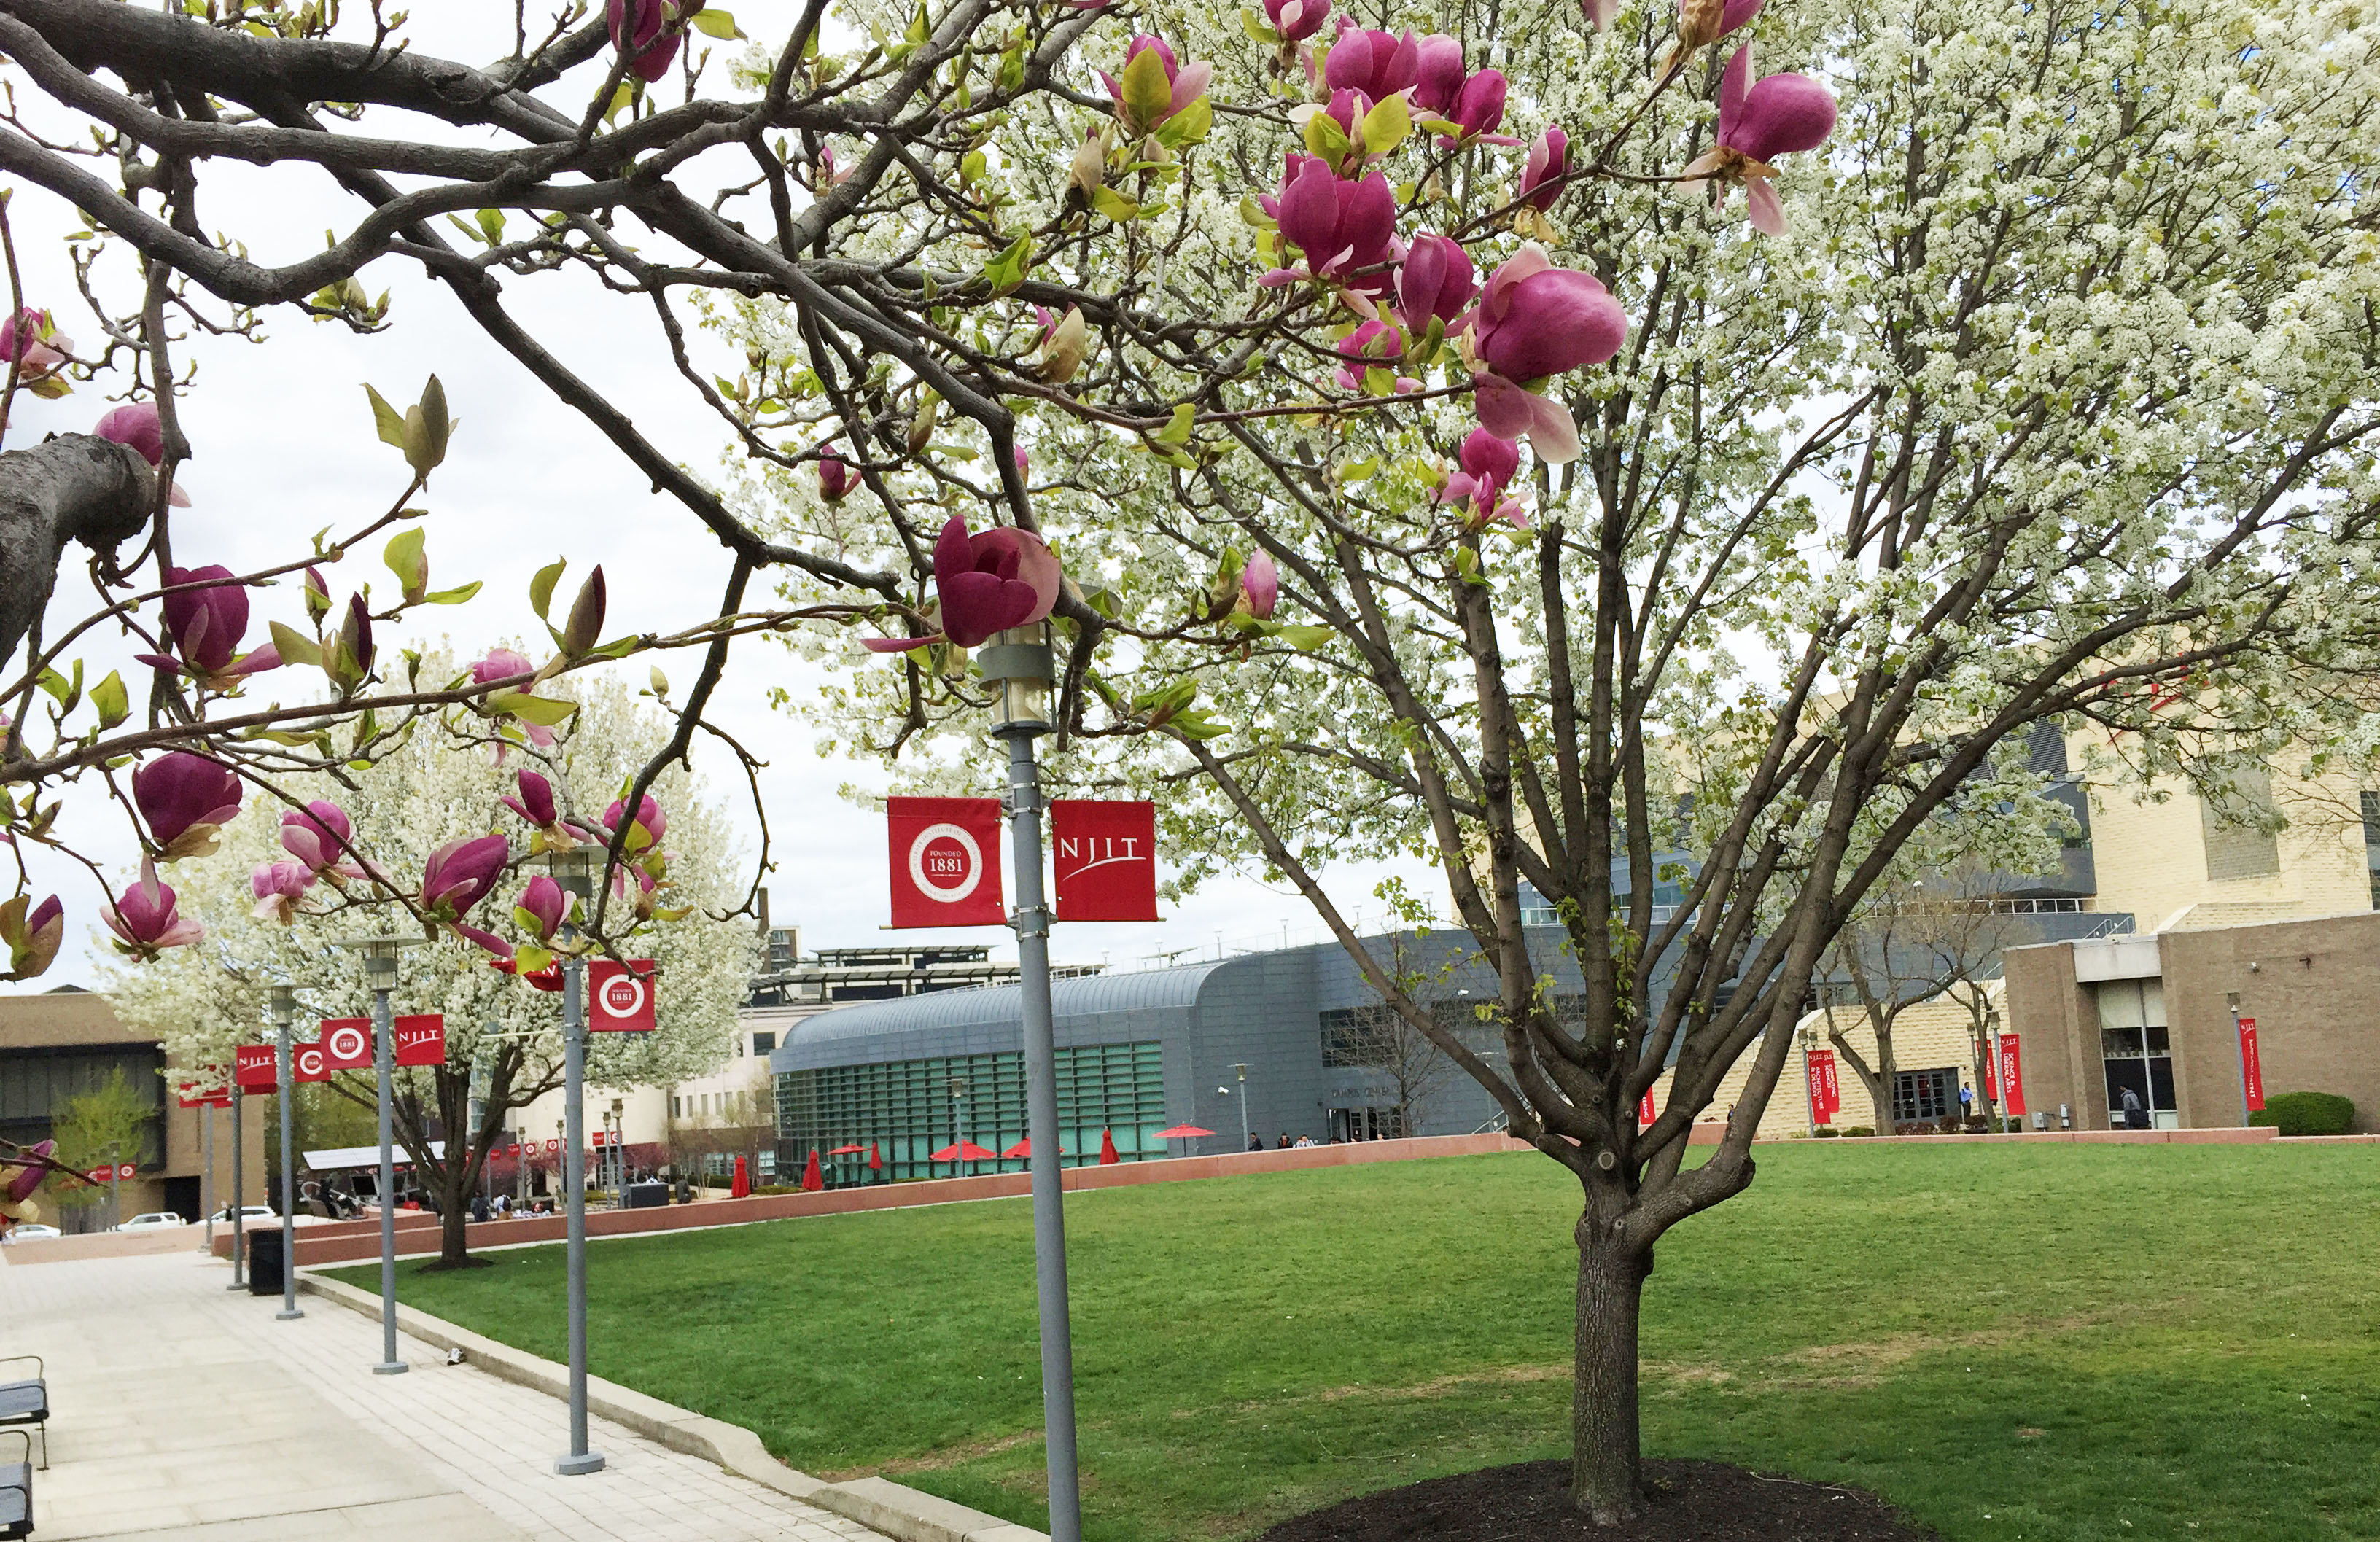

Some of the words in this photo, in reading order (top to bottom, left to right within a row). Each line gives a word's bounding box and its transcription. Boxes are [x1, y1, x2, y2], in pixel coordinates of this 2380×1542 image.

[1060, 837, 1138, 865] NJIT
[930, 858, 963, 872] 1881
[612, 992, 632, 1002] 1881
[399, 1029, 438, 1043] NJIT
[238, 1056, 271, 1067] NJIT
[1816, 1067, 1824, 1110] ARCHITECTURE
